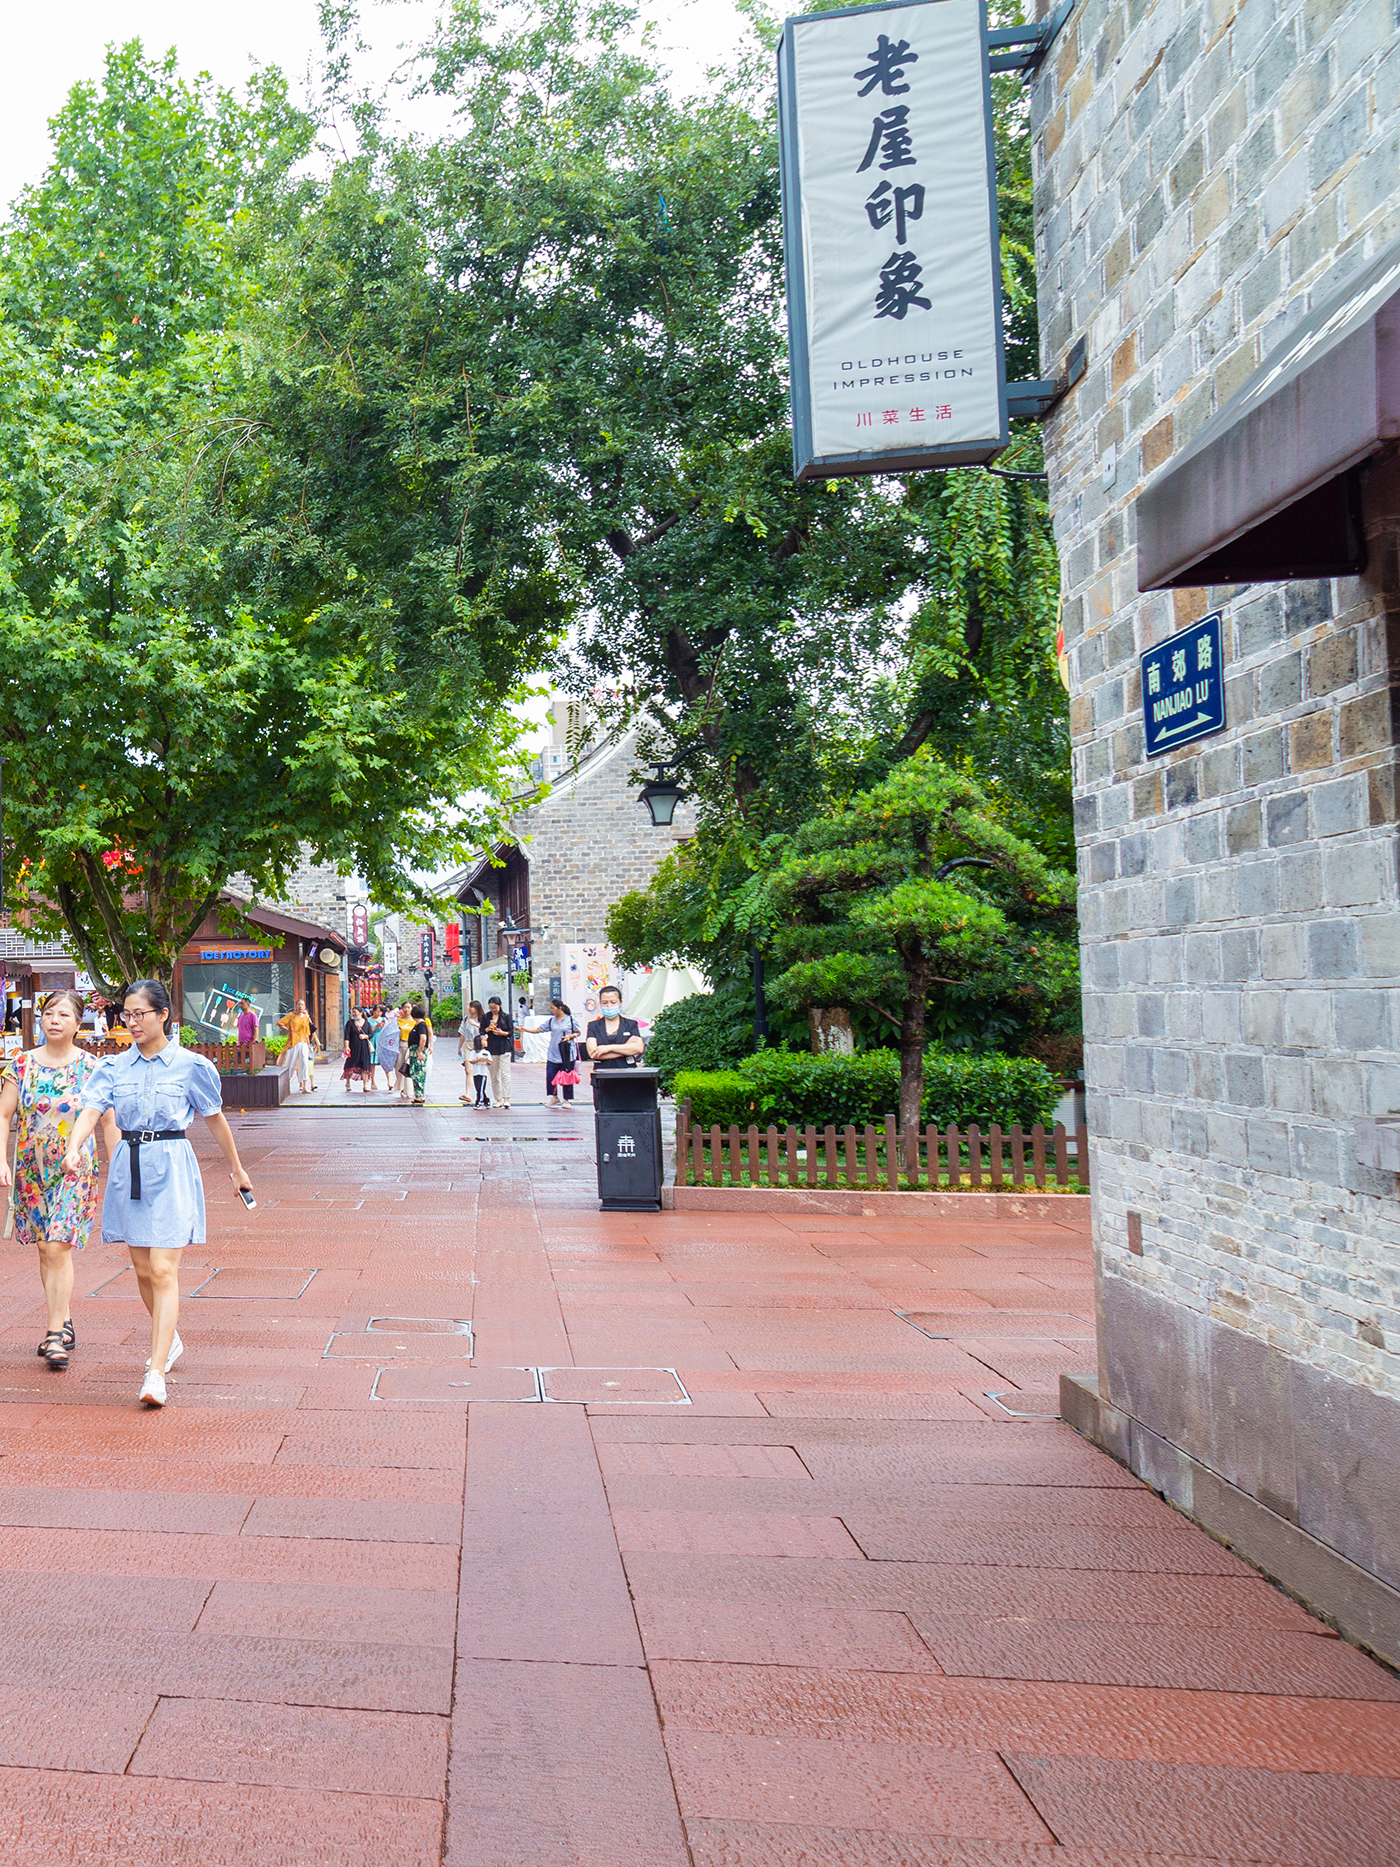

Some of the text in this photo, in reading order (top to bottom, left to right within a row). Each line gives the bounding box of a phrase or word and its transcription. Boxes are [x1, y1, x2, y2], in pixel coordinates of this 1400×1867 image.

[853, 34, 932, 320] 老屋印象
[841, 349, 964, 371] OLDHOUSE
[833, 367, 973, 390] IMPRESSION
[856, 404, 953, 427] 川菜生活
[1147, 634, 1213, 695] 南郊路
[1153, 679, 1209, 723] NANJIAO LU
[201, 949, 271, 960] ICE FACTORY
